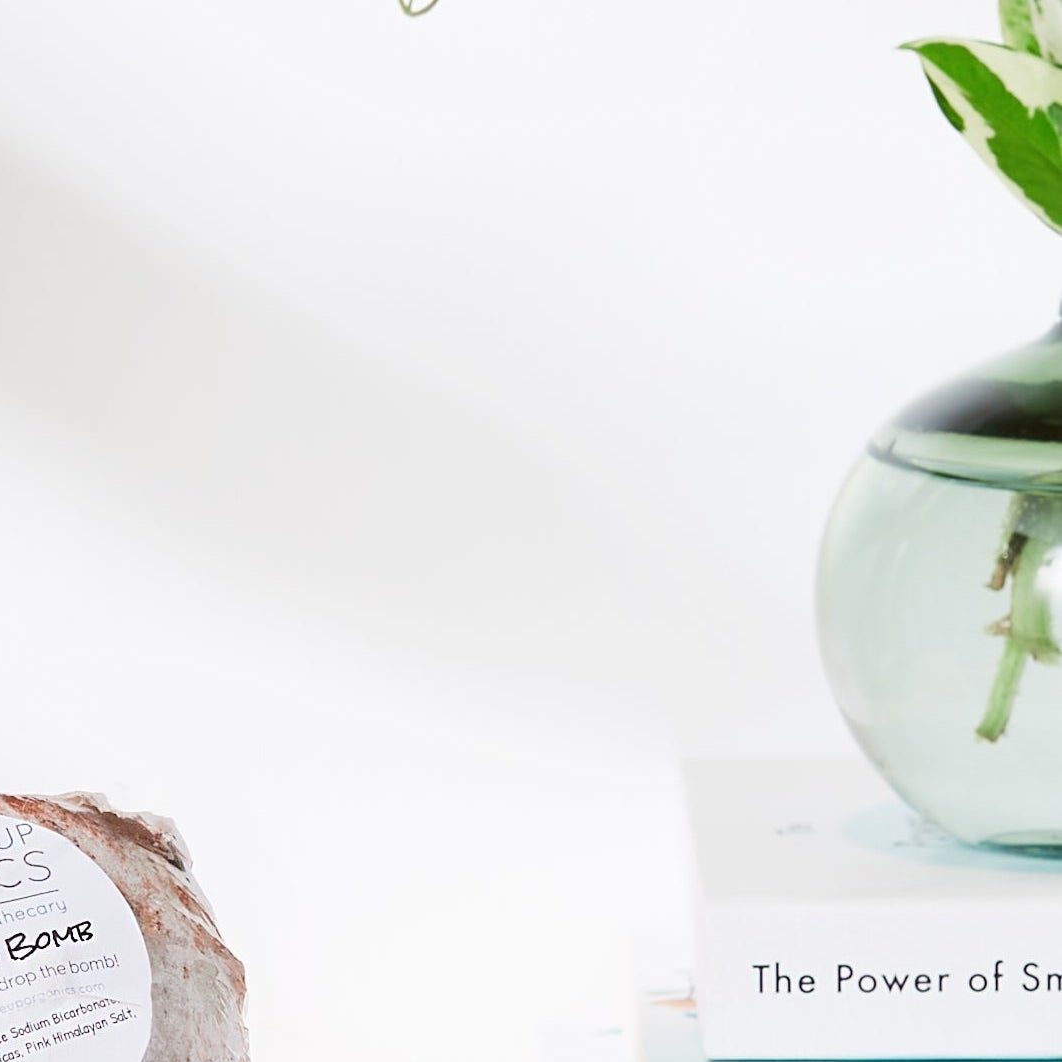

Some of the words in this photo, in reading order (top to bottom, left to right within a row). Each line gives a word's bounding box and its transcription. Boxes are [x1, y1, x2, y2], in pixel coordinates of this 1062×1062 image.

[4, 920, 94, 961] BOMB
[39, 963, 66, 979] the
[69, 954, 121, 975] bomb!
[752, 962, 816, 993] The
[836, 964, 950, 993] Power
[968, 960, 1004, 992] of
[10, 1019, 51, 1039] Sodium
[25, 1037, 52, 1054] Pink
[52, 1019, 109, 1045] Himalayan
[109, 1008, 137, 1024] Salt,
